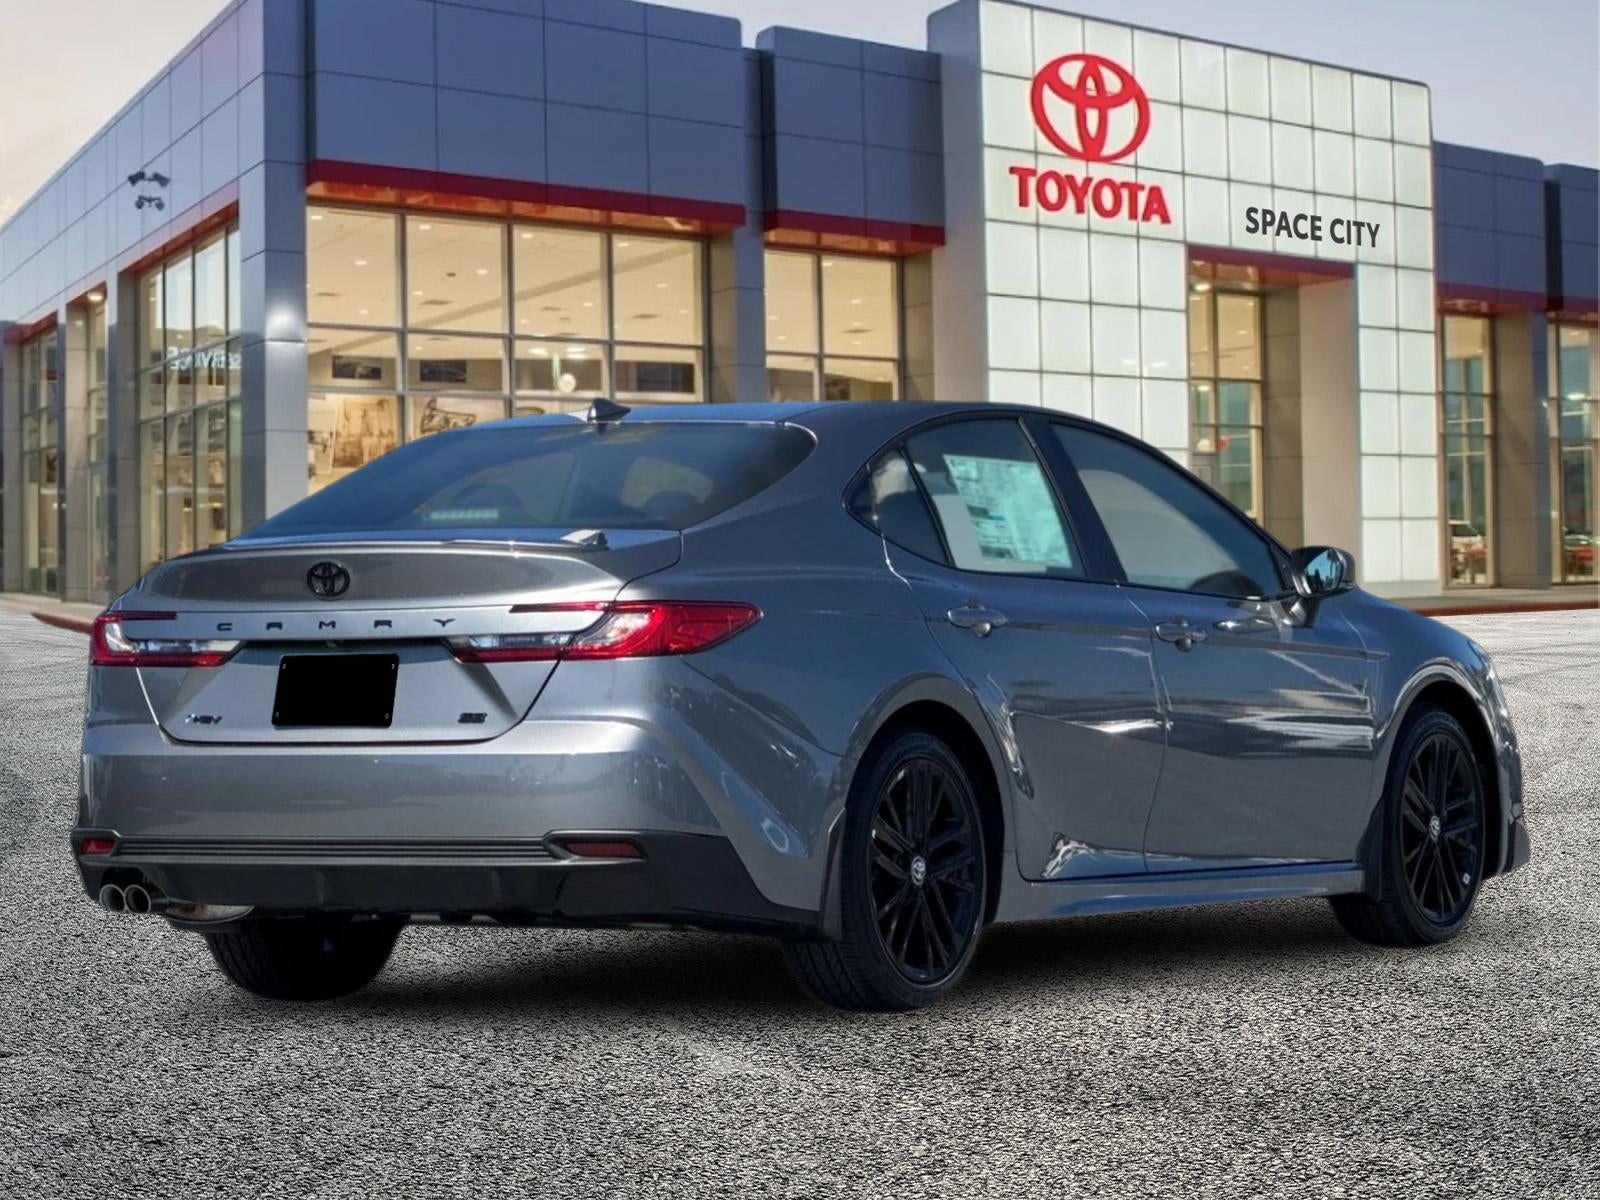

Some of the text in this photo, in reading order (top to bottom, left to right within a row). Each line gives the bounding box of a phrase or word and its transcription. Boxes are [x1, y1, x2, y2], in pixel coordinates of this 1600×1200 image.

[1009, 166, 1171, 224] TOYOTA
[1245, 207, 1380, 247] SPACE CITY
[216, 617, 456, 632] CAMRY
